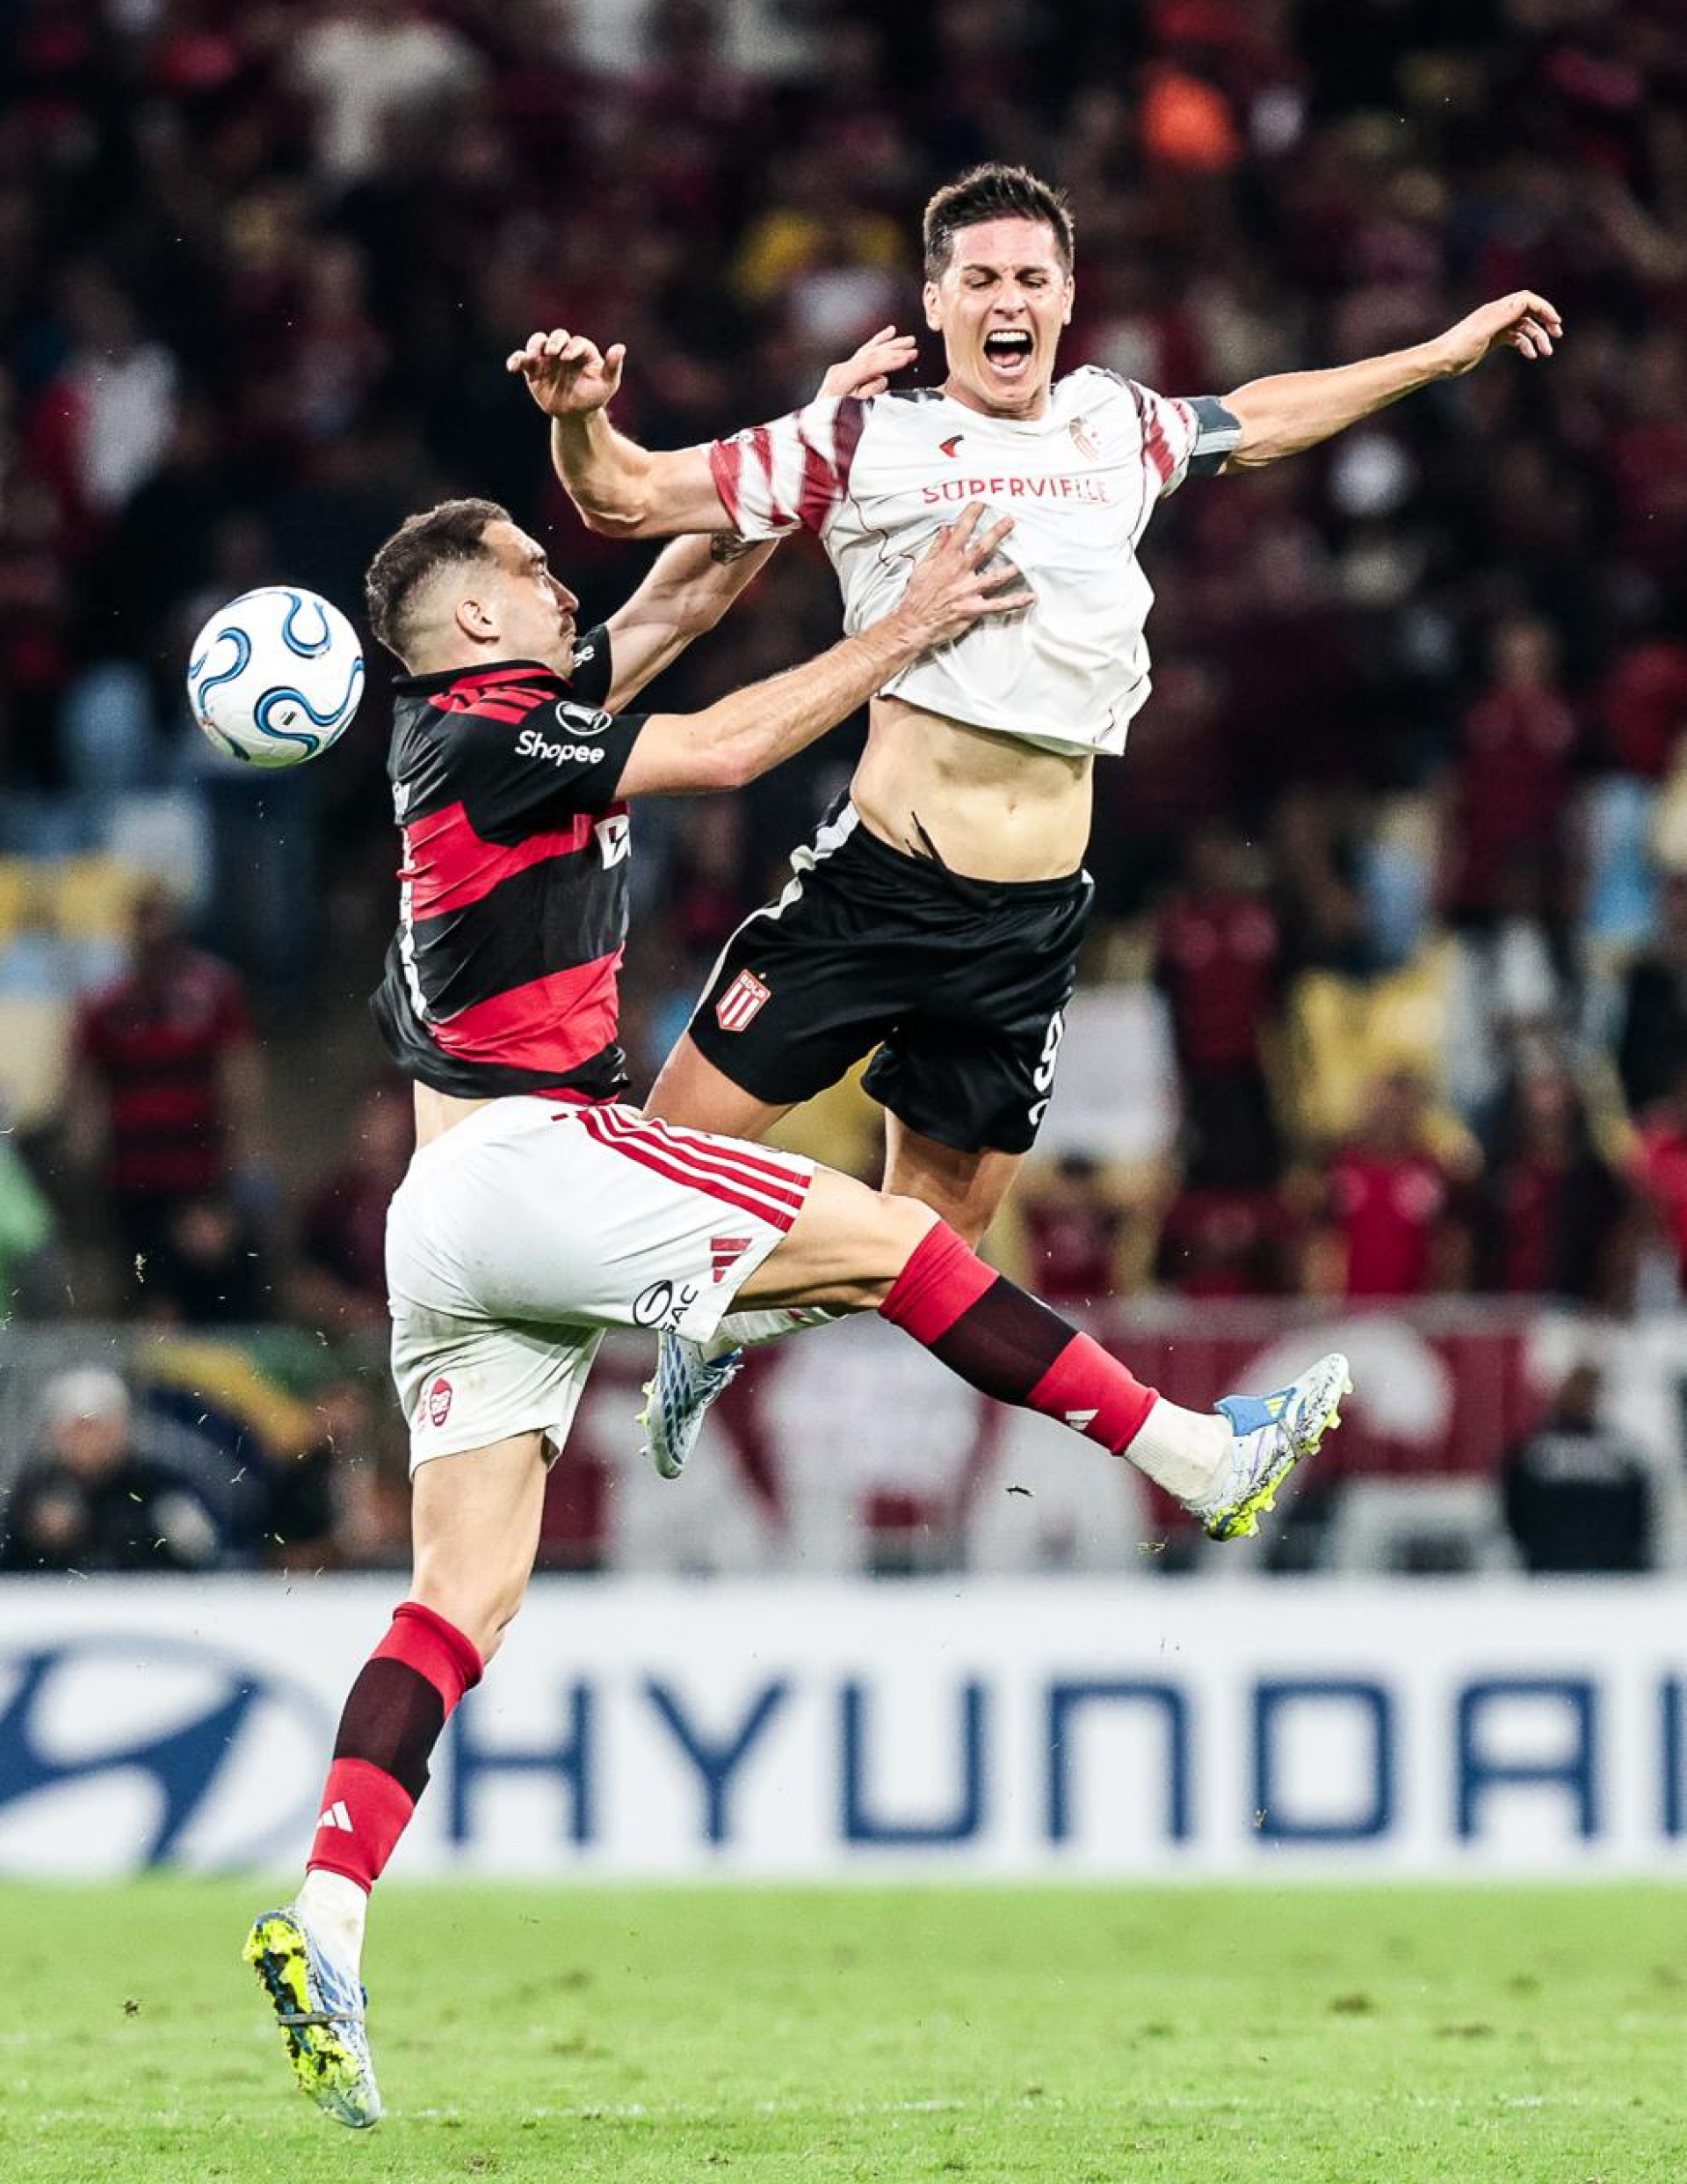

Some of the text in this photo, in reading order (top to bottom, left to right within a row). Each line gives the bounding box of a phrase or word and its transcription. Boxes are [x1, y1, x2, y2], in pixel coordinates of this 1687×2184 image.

[515, 730, 605, 766] Shopee
[1033, 1012, 1064, 1092] 9
[446, 1675, 1687, 1847] HYUNDAI
